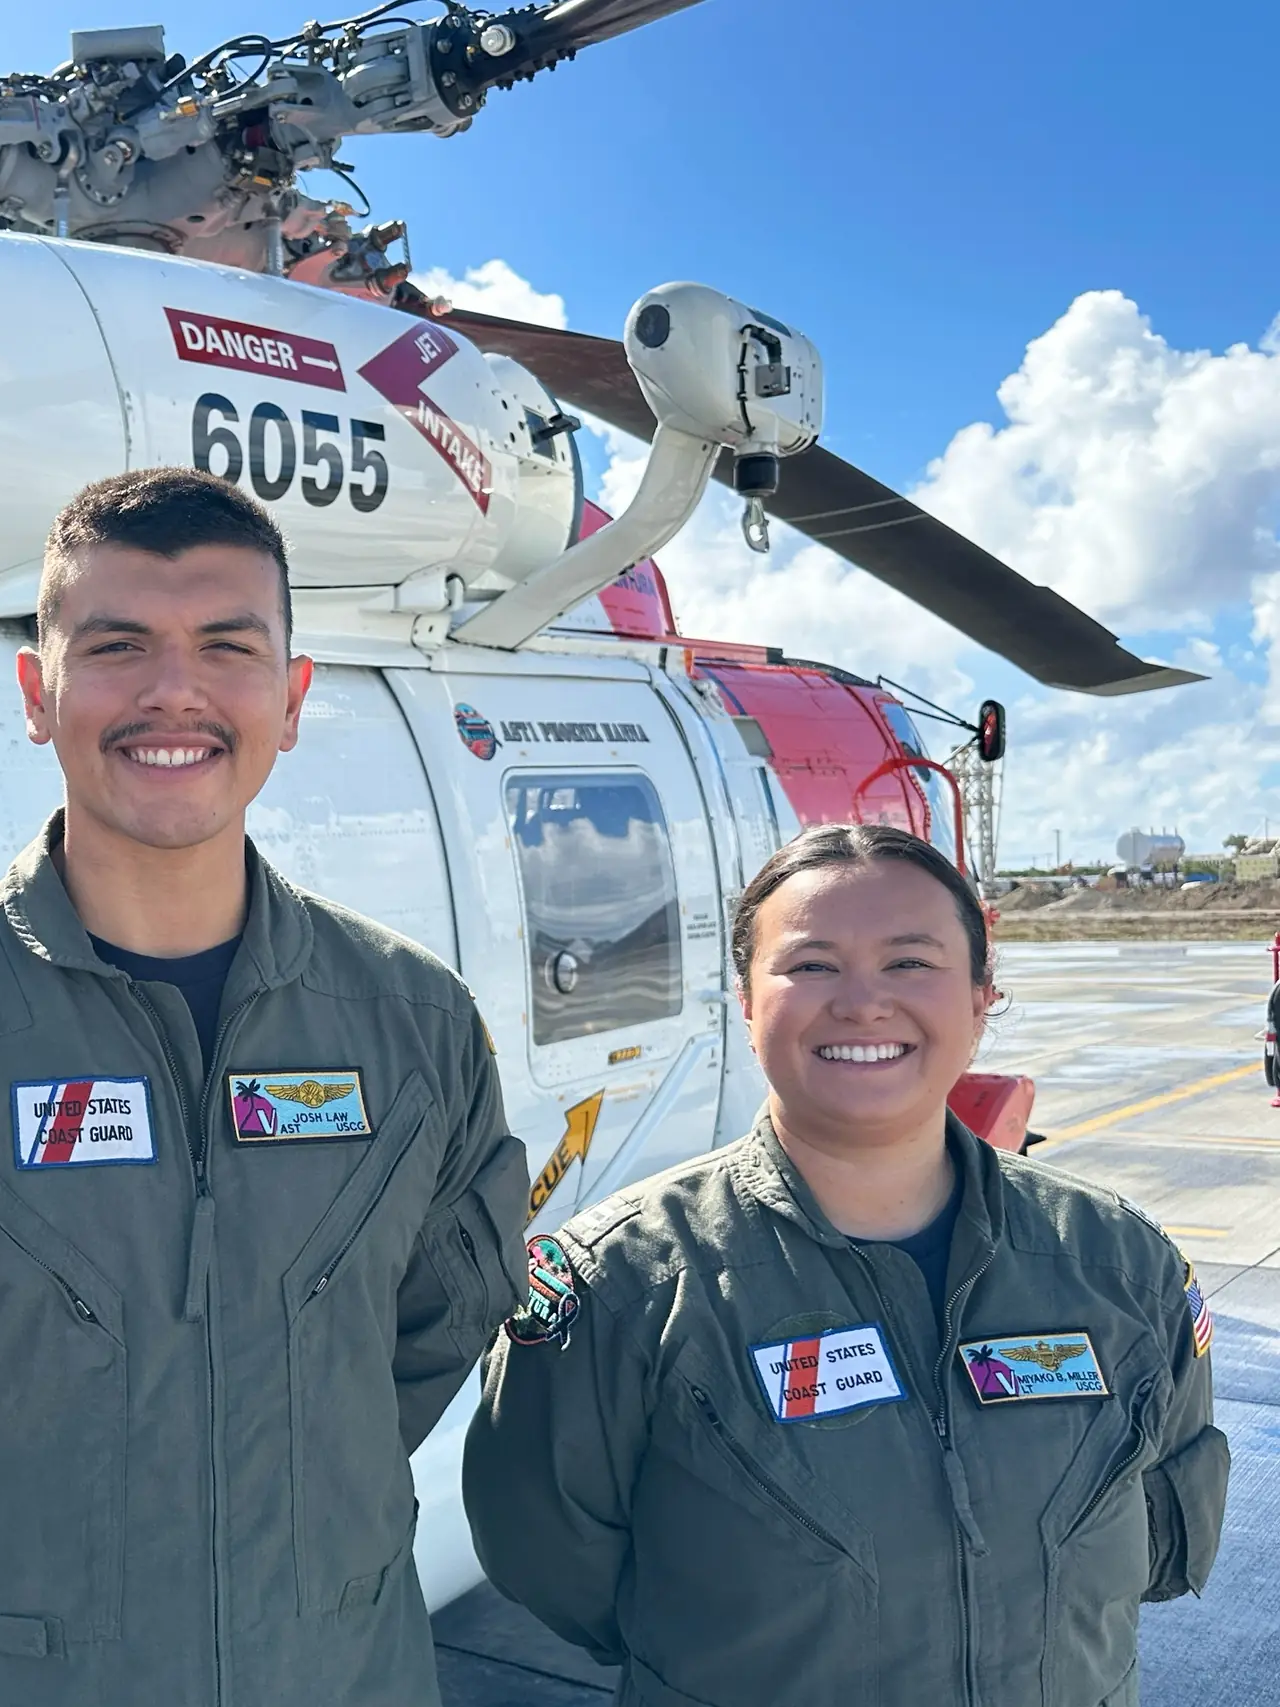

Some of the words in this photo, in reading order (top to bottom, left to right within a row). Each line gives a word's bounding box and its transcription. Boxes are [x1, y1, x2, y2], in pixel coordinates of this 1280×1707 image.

[179, 320, 298, 371] DANGER
[413, 332, 443, 365] JET
[192, 392, 389, 513] 6055
[419, 399, 486, 493] INTAKE
[34, 1100, 81, 1118] UNITED
[88, 1098, 132, 1115] STATES
[292, 1112, 322, 1123] JOSH
[326, 1112, 348, 1122] LAW
[40, 1128, 84, 1145] COAST
[90, 1125, 133, 1142] GUARD
[280, 1123, 301, 1134] AST
[336, 1121, 365, 1132] USCG
[527, 1140, 572, 1212] CUE
[769, 1355, 819, 1375] UNITED
[826, 1343, 876, 1363] STATES
[783, 1382, 827, 1402] COAST
[836, 1370, 883, 1391] GUARD
[1017, 1372, 1054, 1384] MIYAKO
[1069, 1371, 1099, 1381] MILLER
[1021, 1385, 1033, 1394] LT
[1075, 1381, 1102, 1391] USCG
